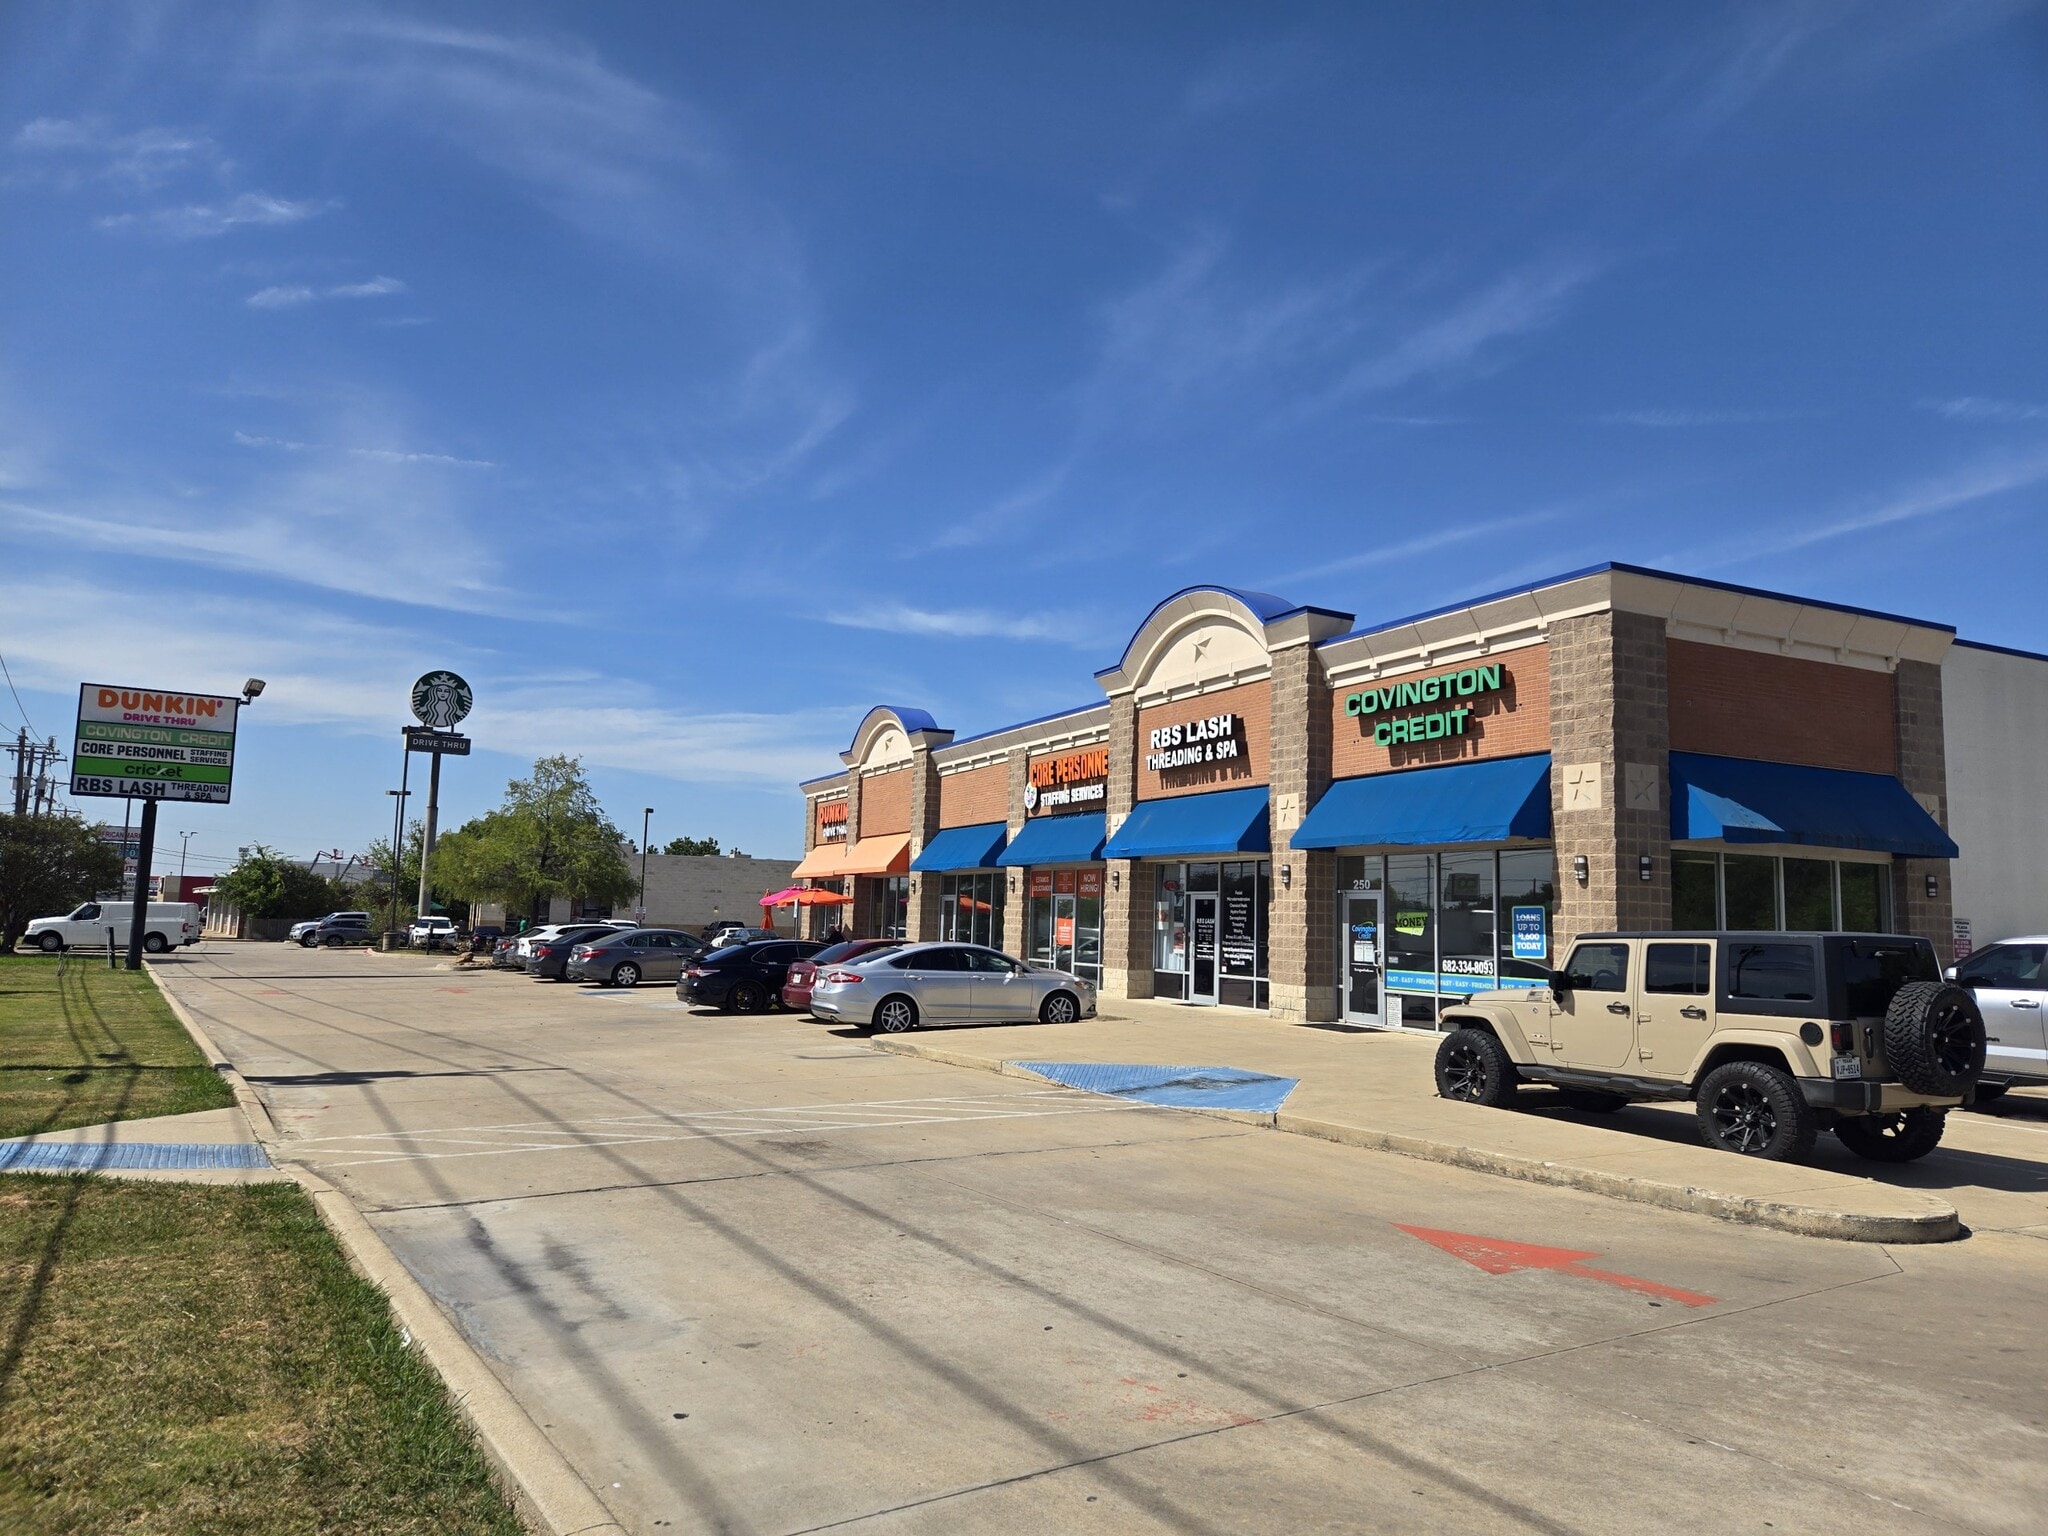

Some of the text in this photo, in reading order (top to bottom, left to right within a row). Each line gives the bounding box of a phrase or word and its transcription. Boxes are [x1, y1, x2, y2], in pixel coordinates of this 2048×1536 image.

[1345, 663, 1503, 717] COVINGTON
[98, 689, 223, 717] DUNKIN'
[123, 713, 196, 726] DRIVE THRU
[1151, 714, 1232, 749] RBS LASH
[1375, 709, 1470, 746] CREDIT
[86, 725, 230, 746] COVINGTON CREDIT
[82, 742, 186, 760] CORE PERSONNEL
[442, 741, 466, 749] THRU
[190, 749, 227, 757] STAFFING
[1146, 739, 1238, 770] THREADING & SPA
[190, 756, 227, 764] SERVICES
[125, 764, 182, 777] cricket
[1030, 749, 1108, 788] CORE PERSONNE
[77, 778, 165, 795] RBS LASH
[171, 783, 226, 793] THREADING
[195, 792, 211, 800] SPA
[1040, 784, 1104, 807] STAFFING SERVICES
[1084, 874, 1096, 882] NOW
[1353, 880, 1370, 889] 250
[1394, 916, 1428, 928] MONEY
[1517, 923, 1528, 931] UP
[1352, 924, 1376, 934] Covington
[1516, 942, 1542, 950] TODAY
[1442, 960, 1493, 975] 682-334-8093
